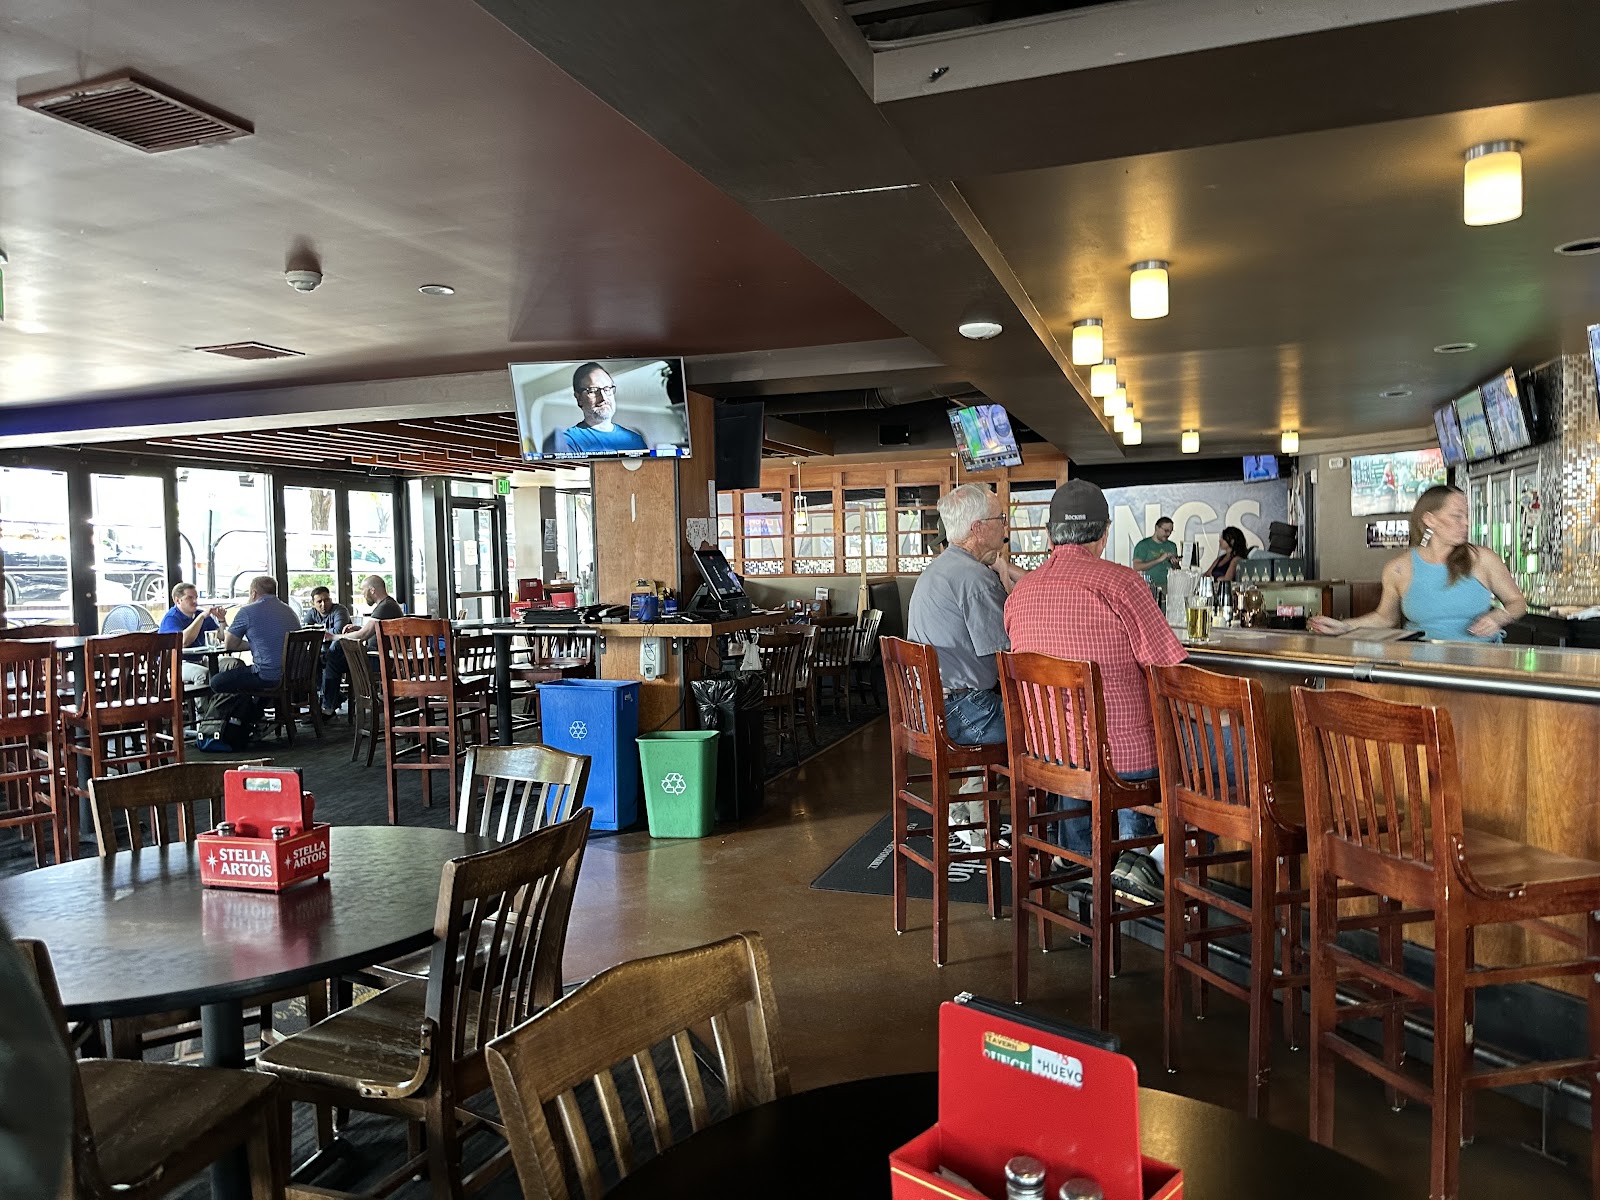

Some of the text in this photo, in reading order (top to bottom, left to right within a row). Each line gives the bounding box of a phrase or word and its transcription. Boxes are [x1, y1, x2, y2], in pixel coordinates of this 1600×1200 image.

[219, 848, 270, 863] STELLA
[293, 841, 326, 859] STELLA
[294, 850, 327, 869] ARTOIS
[221, 862, 272, 878] ARTOIS
